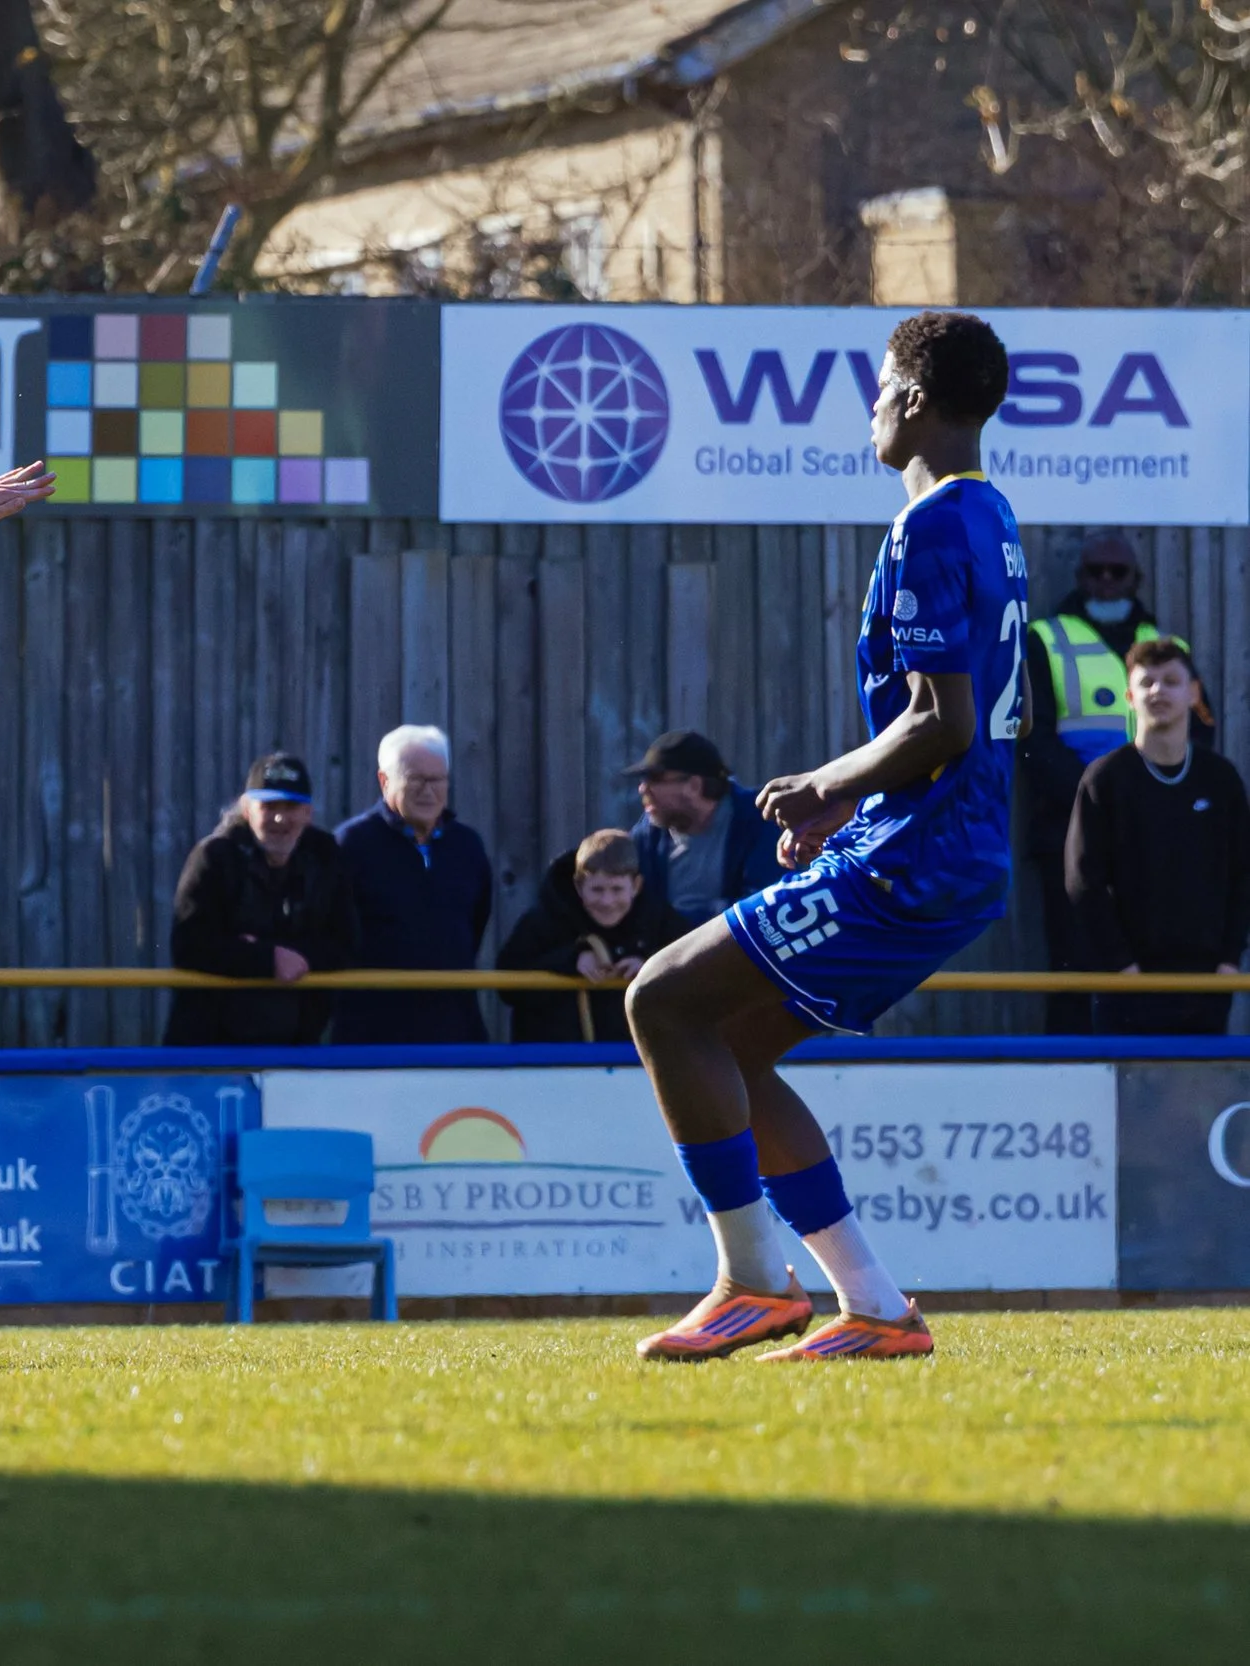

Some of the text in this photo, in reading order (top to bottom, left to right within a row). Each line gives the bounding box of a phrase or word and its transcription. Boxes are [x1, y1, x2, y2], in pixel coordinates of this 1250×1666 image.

[694, 348, 1191, 429] WSA
[695, 446, 793, 476] Global
[989, 449, 1190, 484] Management
[990, 599, 1028, 740] 2
[826, 1122, 1092, 1161] 1553 772348
[466, 1179, 655, 1212] PRODUCE
[425, 1240, 629, 1260] INSPIRATION
[111, 1260, 219, 1294] CIAT
